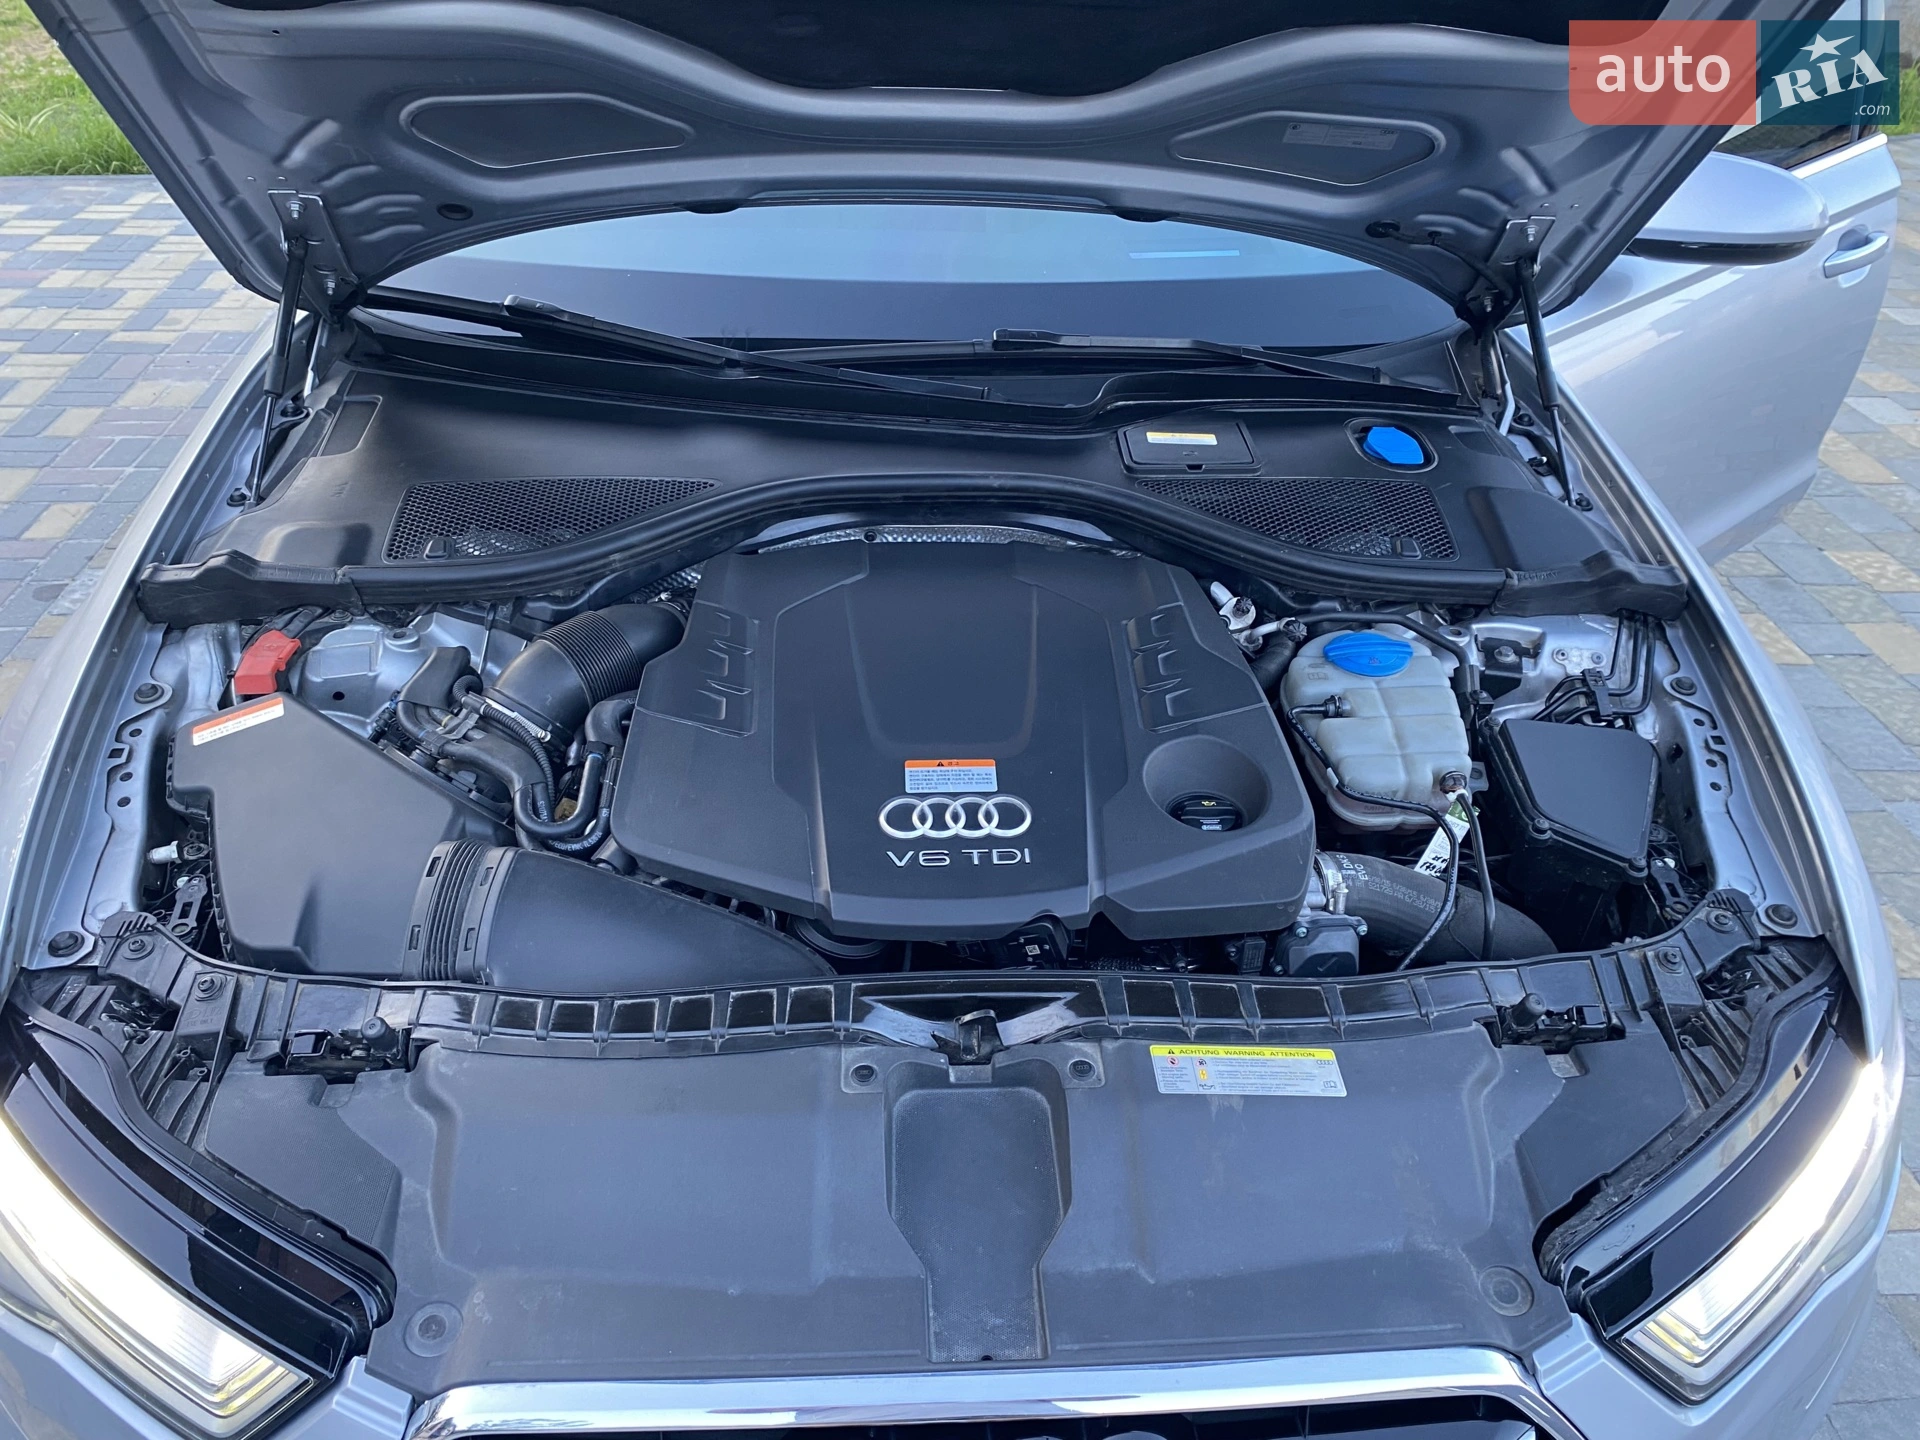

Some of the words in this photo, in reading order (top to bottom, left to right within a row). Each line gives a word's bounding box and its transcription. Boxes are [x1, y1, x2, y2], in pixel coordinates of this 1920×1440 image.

[886, 850, 951, 867] V6
[961, 848, 1031, 866] TDI
[1354, 863, 1369, 881] EVO
[1223, 1049, 1267, 1057] WARNING
[1269, 1050, 1316, 1058] ATTENTION
